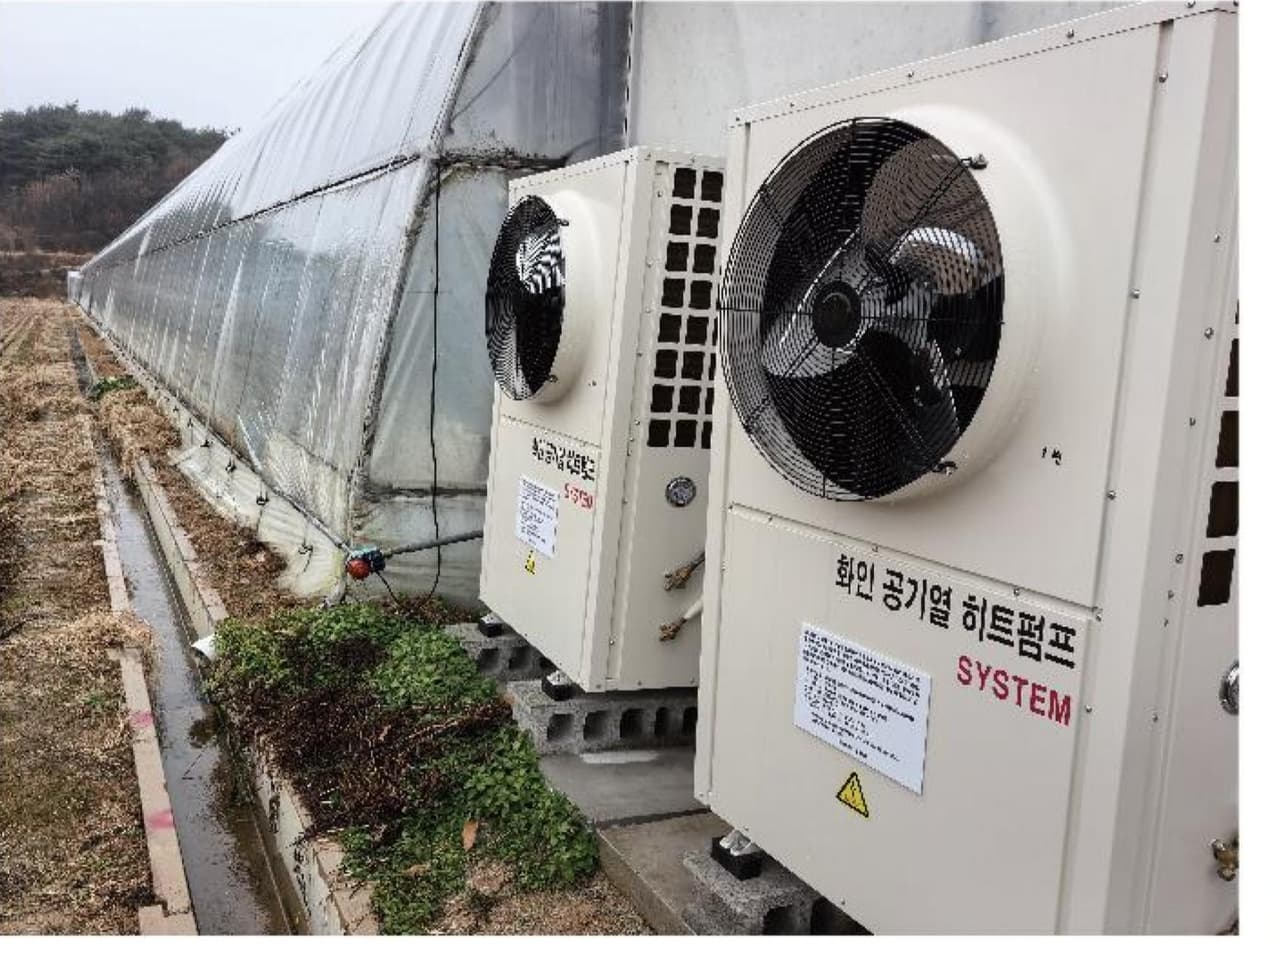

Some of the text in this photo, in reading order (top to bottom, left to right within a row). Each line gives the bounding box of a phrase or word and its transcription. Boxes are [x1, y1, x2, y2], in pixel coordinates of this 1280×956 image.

[836, 553, 1076, 669] 화인 공기열 히트펌프
[957, 655, 1071, 726] SYSTEM
